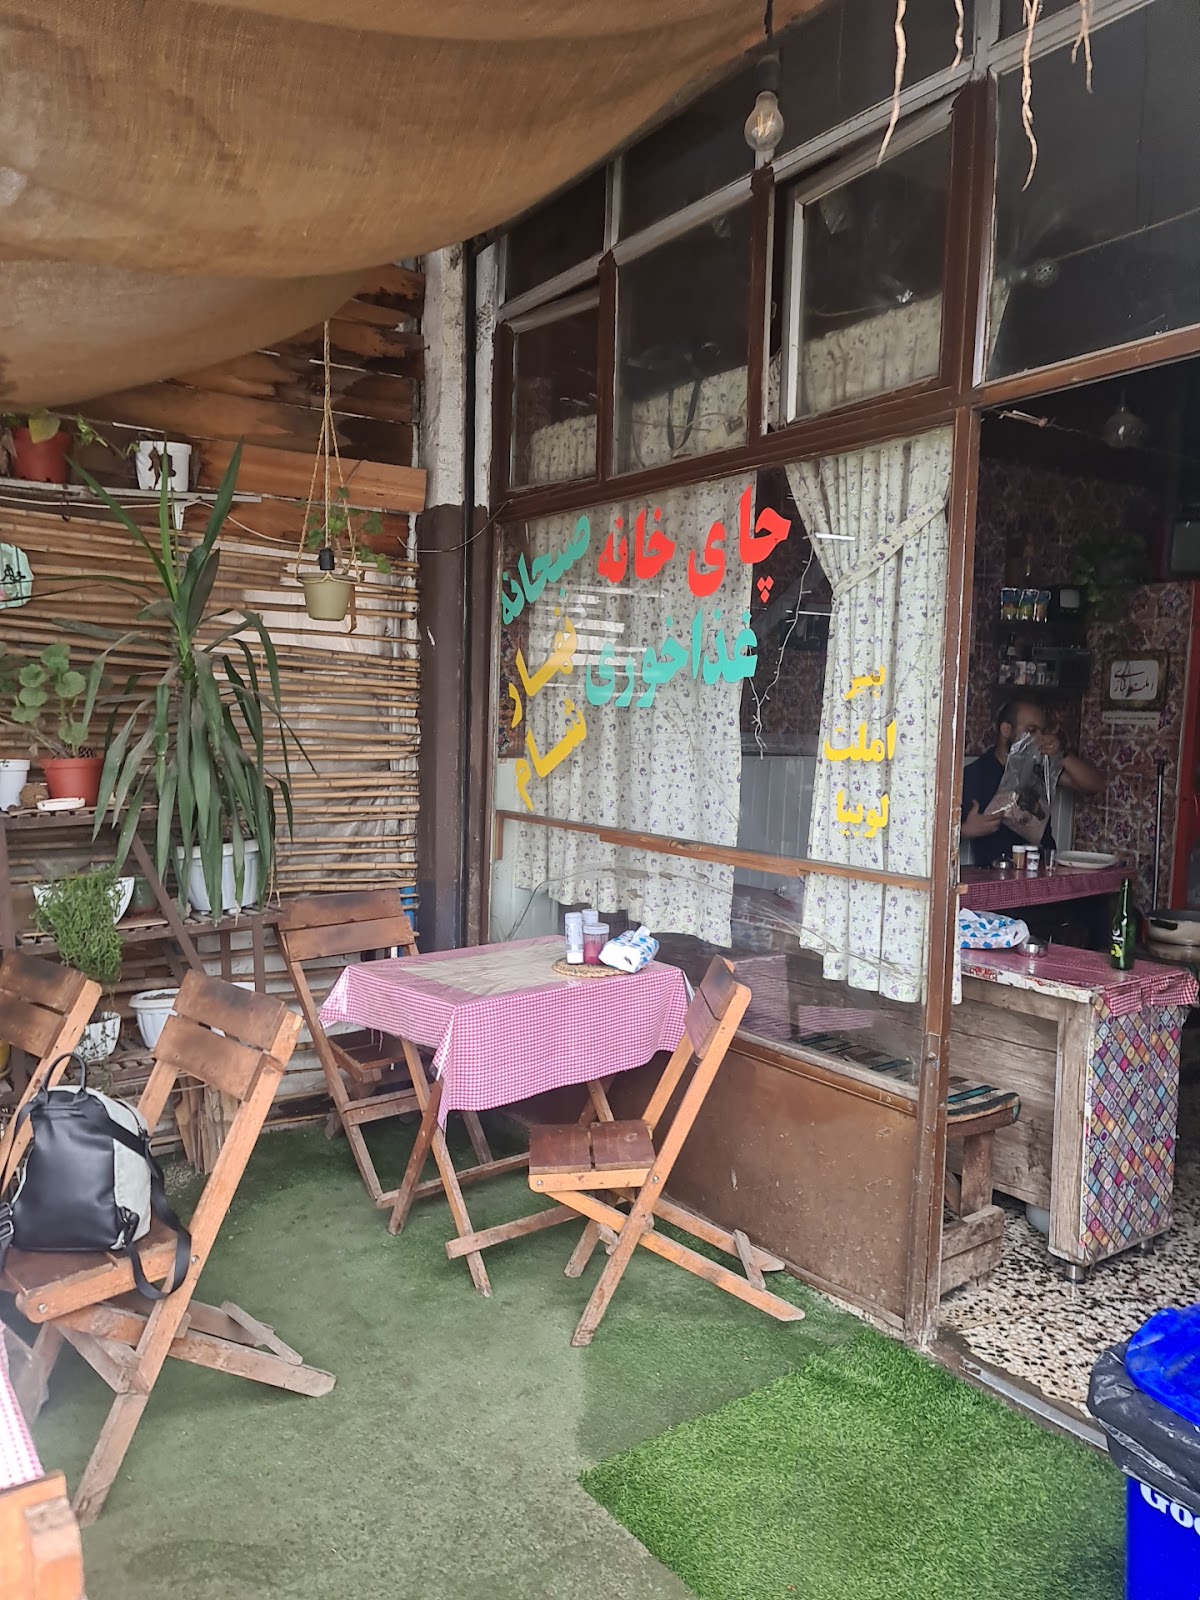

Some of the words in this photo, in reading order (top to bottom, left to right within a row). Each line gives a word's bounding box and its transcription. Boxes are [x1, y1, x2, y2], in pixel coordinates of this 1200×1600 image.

[501, 515, 590, 625] صبحانه
[597, 506, 676, 583] خانه
[687, 484, 792, 603] چای
[508, 606, 579, 729] نهار
[514, 697, 588, 812] شام
[824, 720, 897, 763] املت
[835, 789, 890, 838] لوبیا
